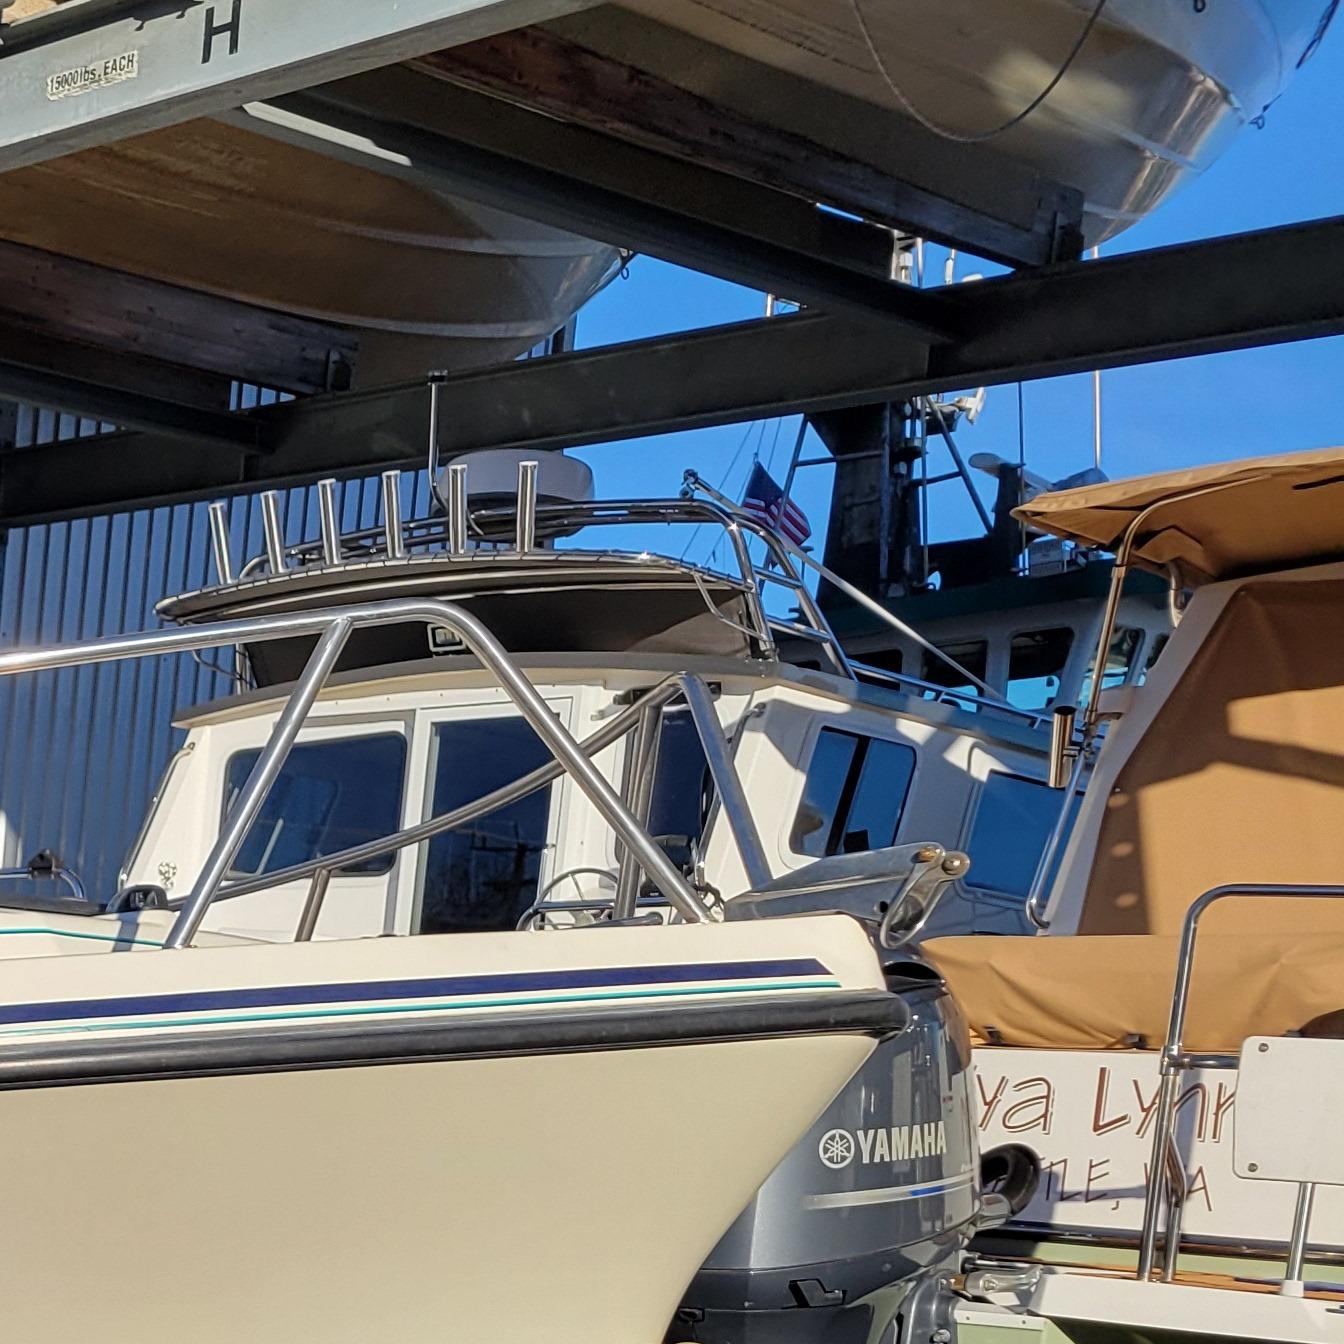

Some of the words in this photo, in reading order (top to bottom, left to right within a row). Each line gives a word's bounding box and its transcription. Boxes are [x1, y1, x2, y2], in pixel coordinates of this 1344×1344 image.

[201, 0, 242, 64] H
[973, 1065, 1056, 1135] ya
[855, 1120, 948, 1164] YAMAHA
